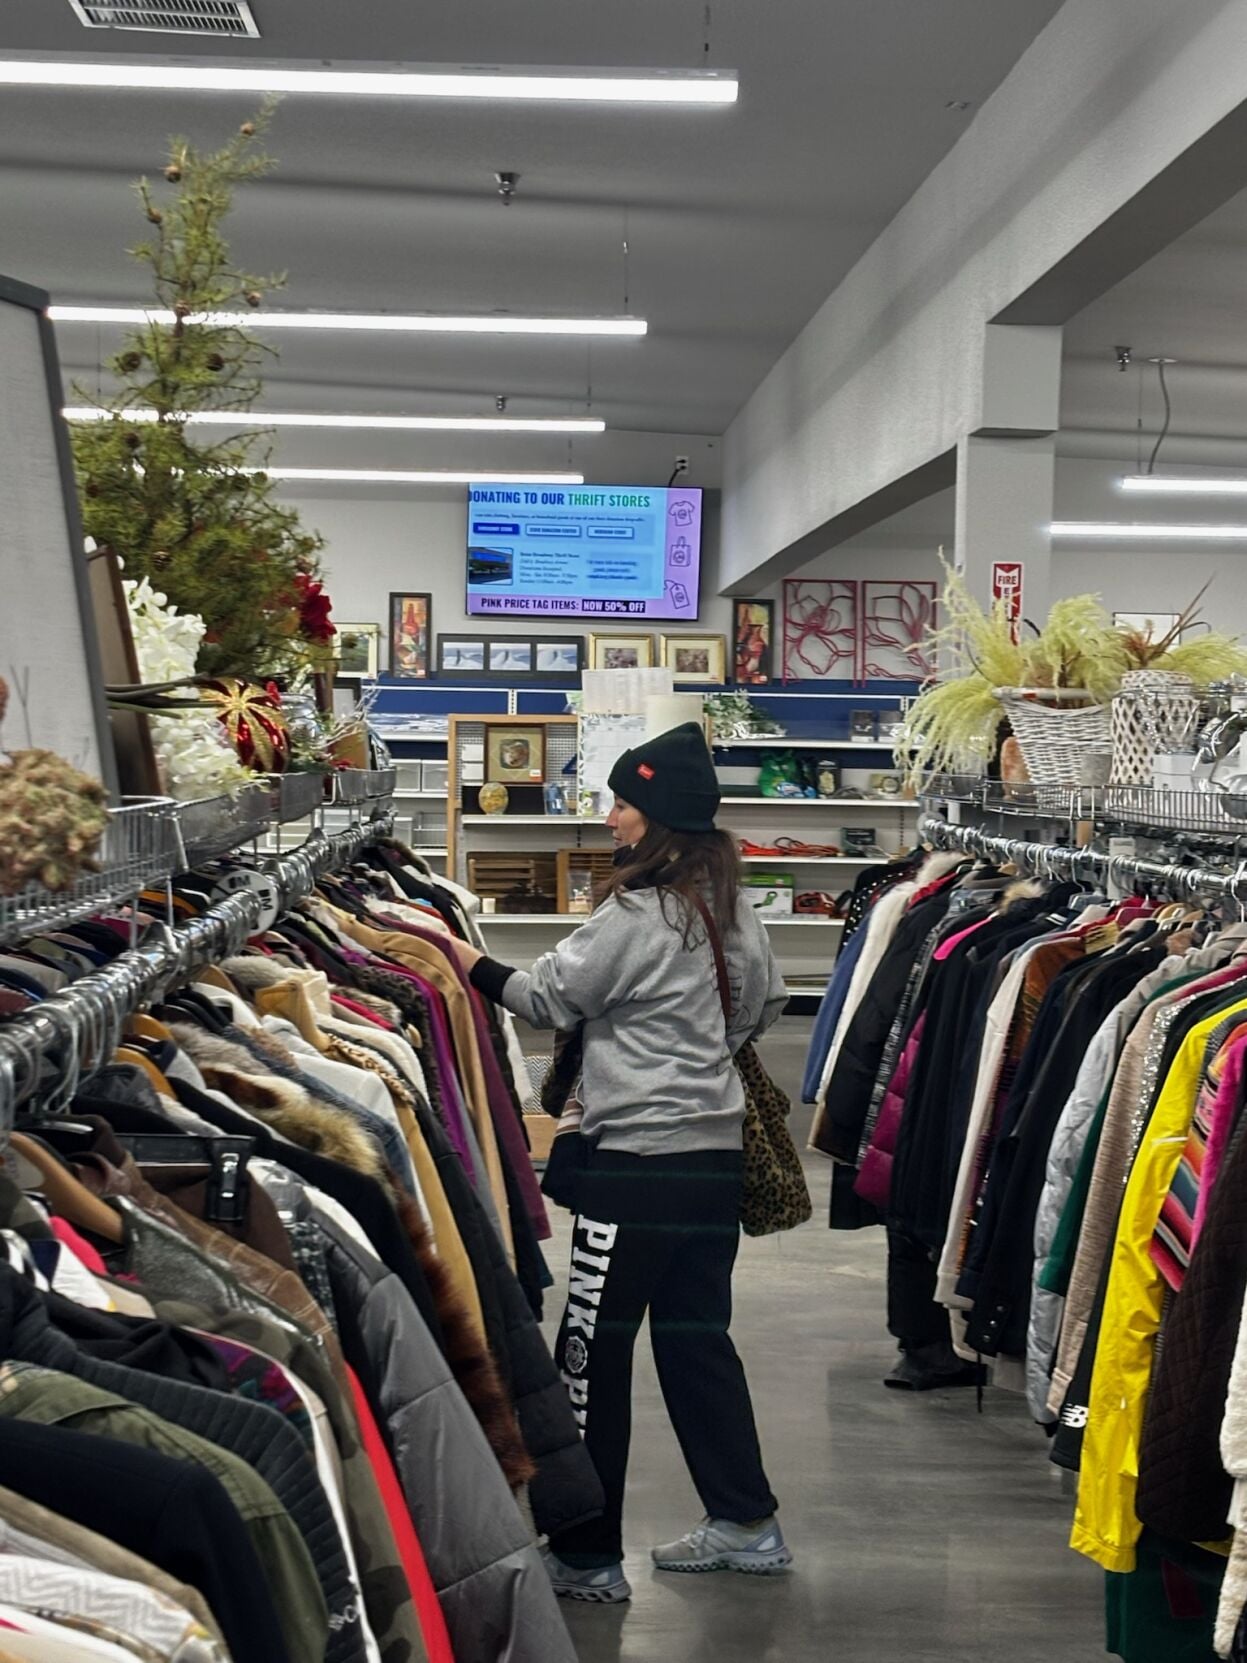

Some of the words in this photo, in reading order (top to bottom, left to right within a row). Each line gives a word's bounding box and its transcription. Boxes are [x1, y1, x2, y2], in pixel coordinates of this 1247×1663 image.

[524, 492, 538, 505] TO
[541, 493, 565, 505] OUR
[568, 493, 606, 506] THRIFT
[609, 495, 651, 508] STORES
[997, 575, 1017, 585] FIRE
[481, 598, 503, 608] PINK
[504, 599, 530, 609] PRICE
[532, 599, 549, 610] TAG
[551, 600, 580, 610] ITEMS:
[583, 600, 603, 611] NOW
[604, 601, 627, 612] 50%
[628, 602, 644, 612] OFF
[567, 1214, 618, 1340] PINK
